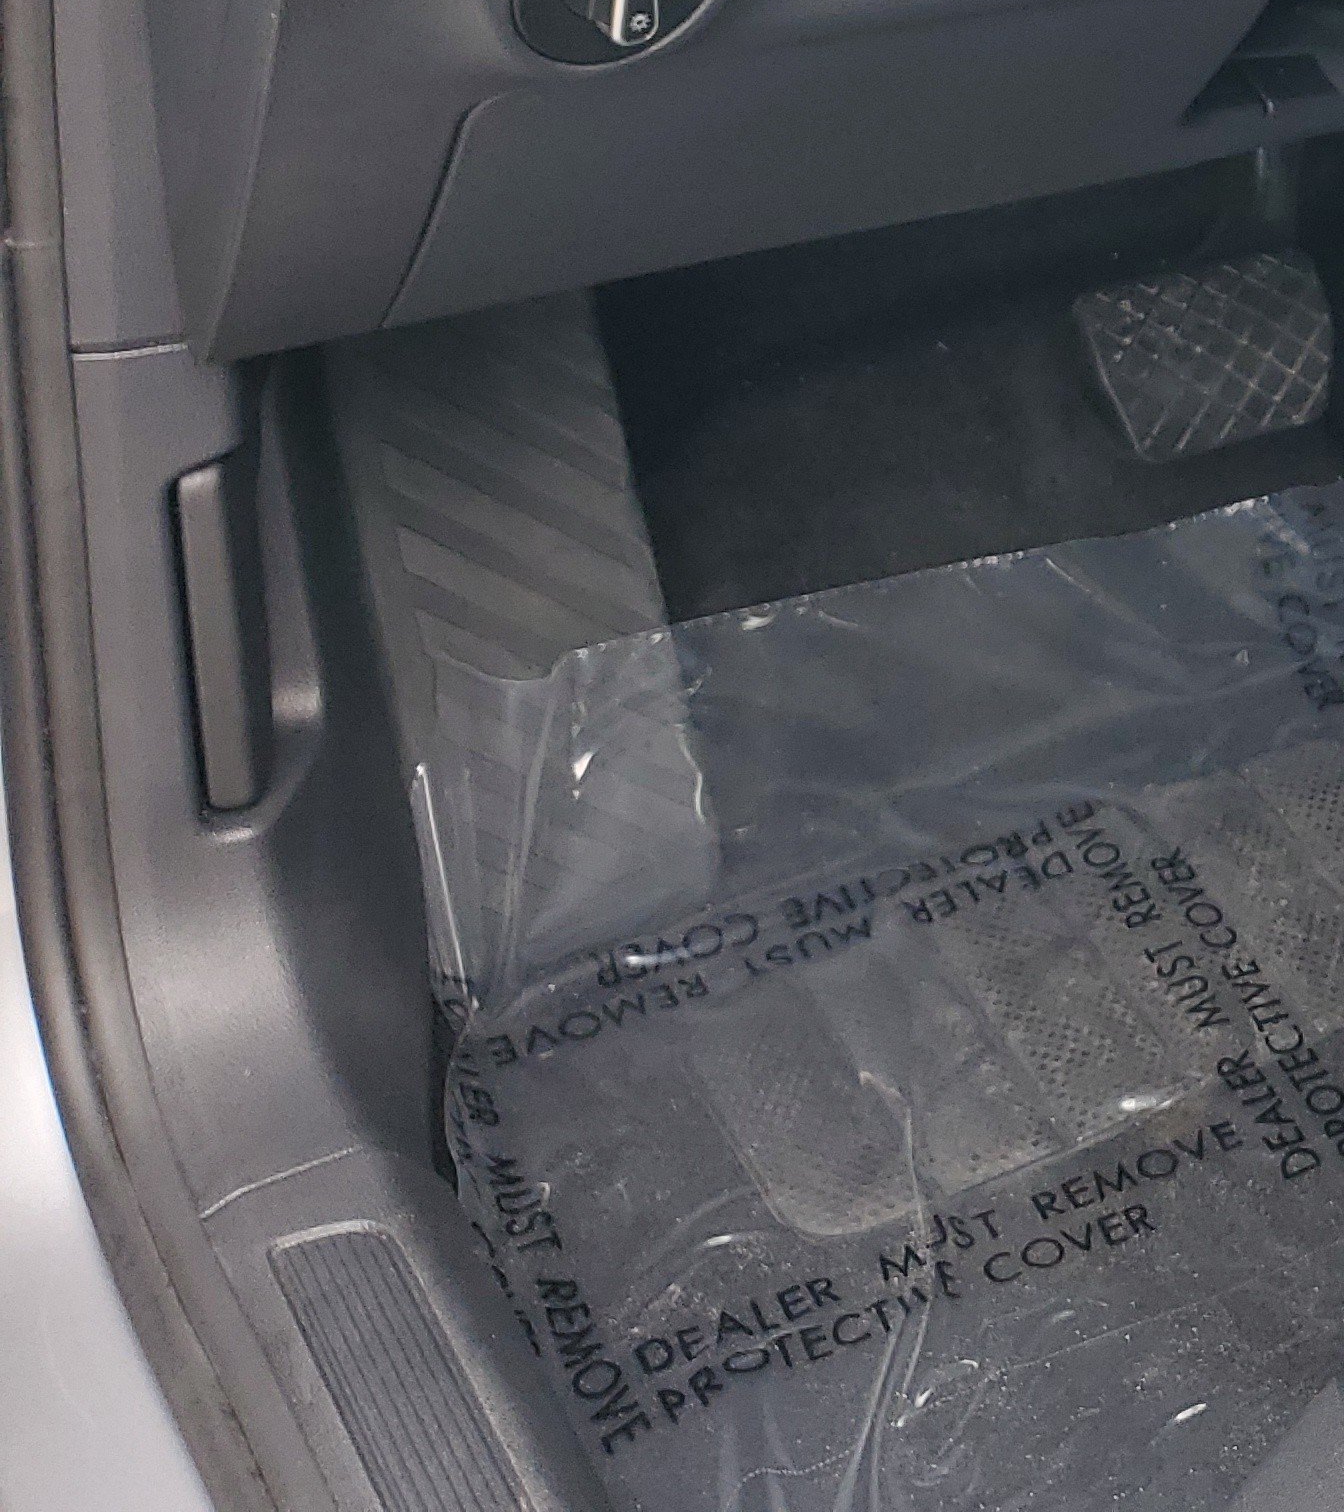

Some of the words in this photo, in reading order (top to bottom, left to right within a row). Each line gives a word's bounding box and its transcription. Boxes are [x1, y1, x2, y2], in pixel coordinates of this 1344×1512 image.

[779, 818, 1054, 931] PROTECTIVE
[903, 849, 1075, 925] DEALER
[1056, 799, 1162, 930] REMOVE
[1150, 845, 1238, 950] COVER
[744, 917, 873, 979] MUST
[1143, 939, 1230, 1033] MUST
[485, 972, 711, 1068] REMOVE
[1217, 1050, 1322, 1180] DEALER
[635, 1276, 842, 1377] DEALER
[1030, 1120, 1245, 1221] REMOVE
[984, 1202, 1159, 1285] COVER
[486, 1155, 565, 1254] MUST
[535, 1276, 654, 1457] REMOVE
